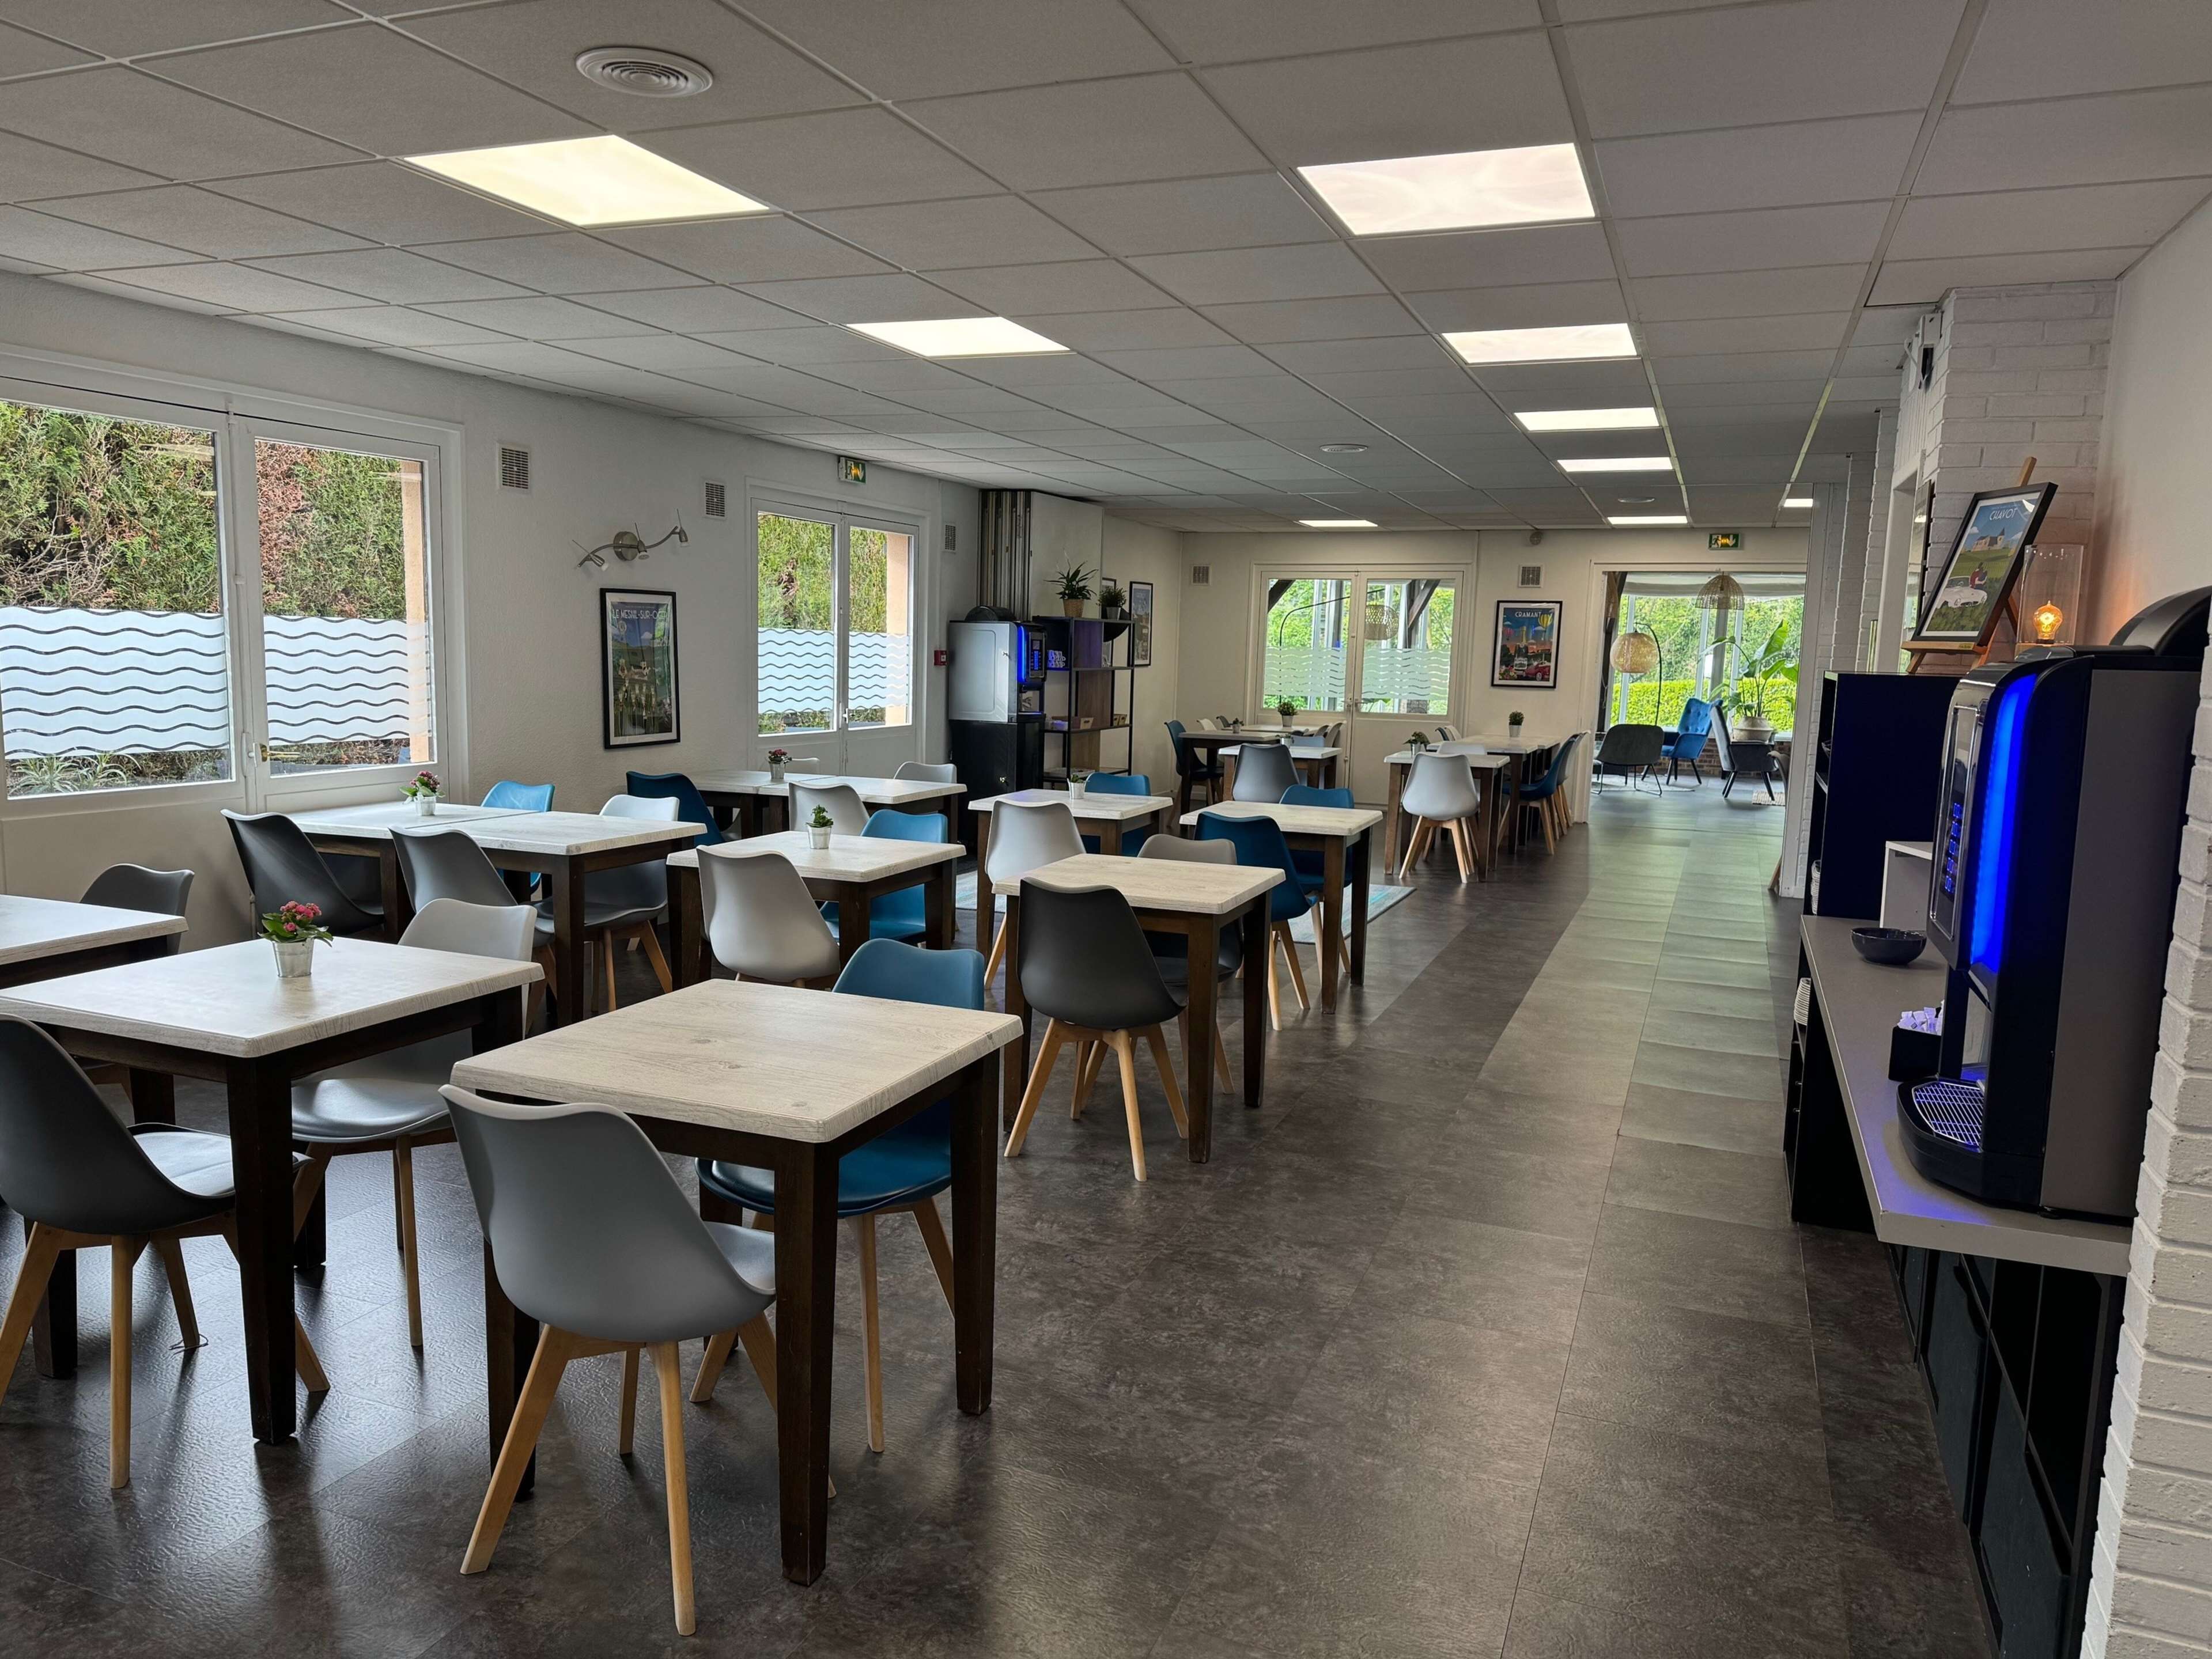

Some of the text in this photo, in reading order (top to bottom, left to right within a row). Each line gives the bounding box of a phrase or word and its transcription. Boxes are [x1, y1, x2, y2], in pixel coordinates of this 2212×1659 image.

[1990, 507, 2018, 520] CHAVOT
[612, 609, 668, 620] LE MESNIL-SUR-OG
